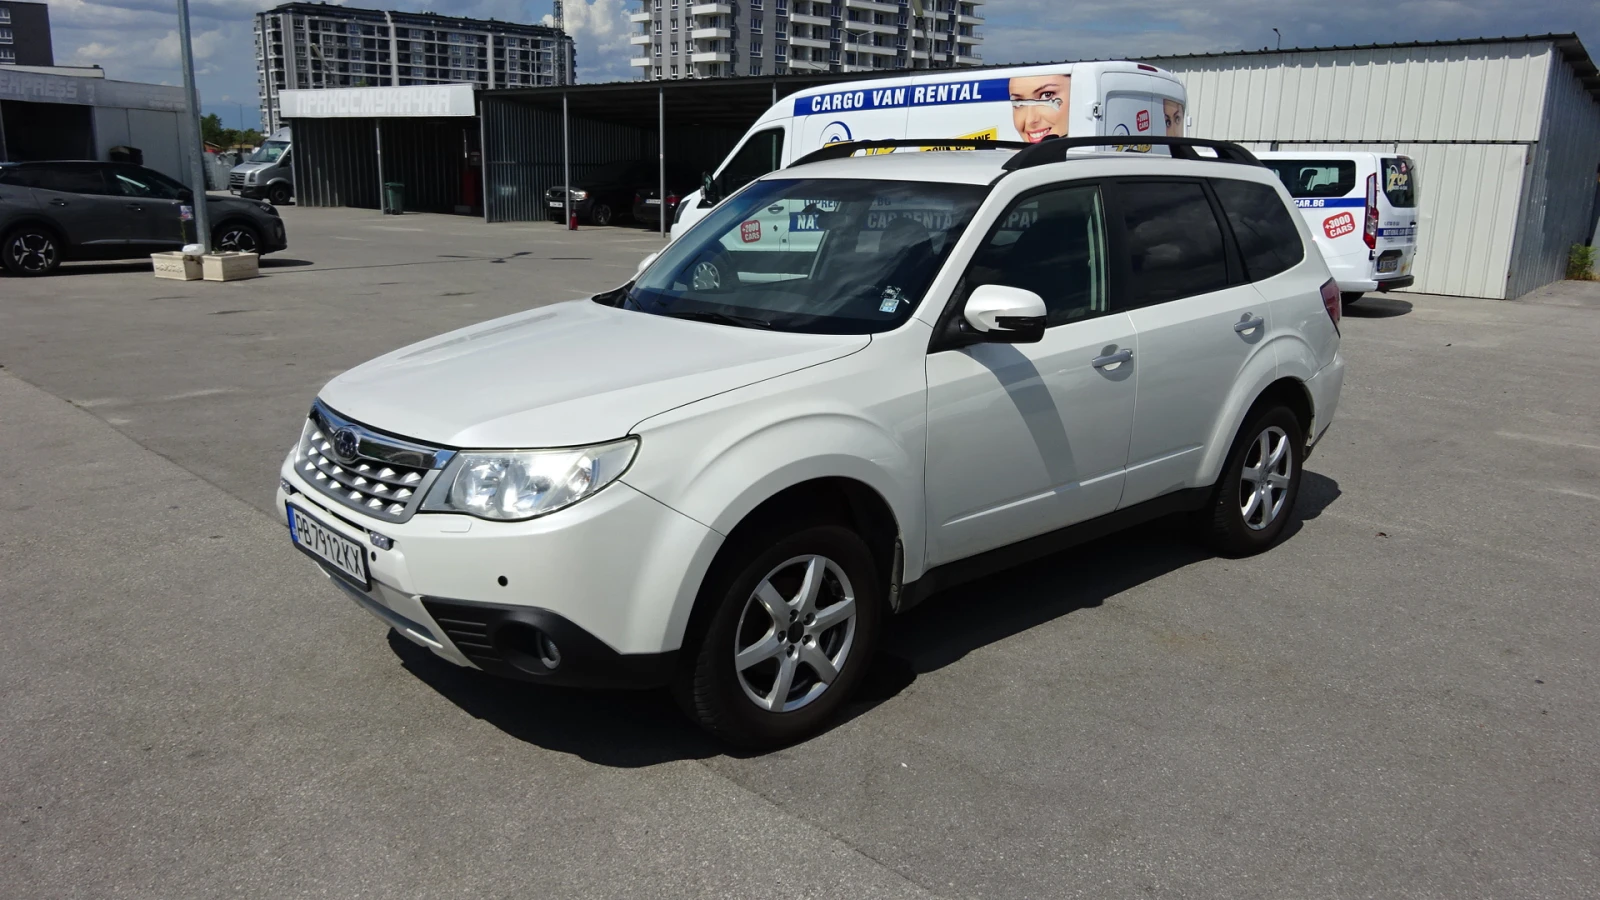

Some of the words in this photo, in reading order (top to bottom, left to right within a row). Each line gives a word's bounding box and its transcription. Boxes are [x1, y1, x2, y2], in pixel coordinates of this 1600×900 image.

[296, 89, 451, 114] ПРАХОСМУКАЧКА
[811, 92, 864, 112] CARGO
[872, 89, 905, 107] VAN
[913, 82, 982, 104] RENTAL
[1325, 214, 1351, 230] +3000
[1329, 223, 1353, 237] CARS
[745, 231, 760, 240] CARS
